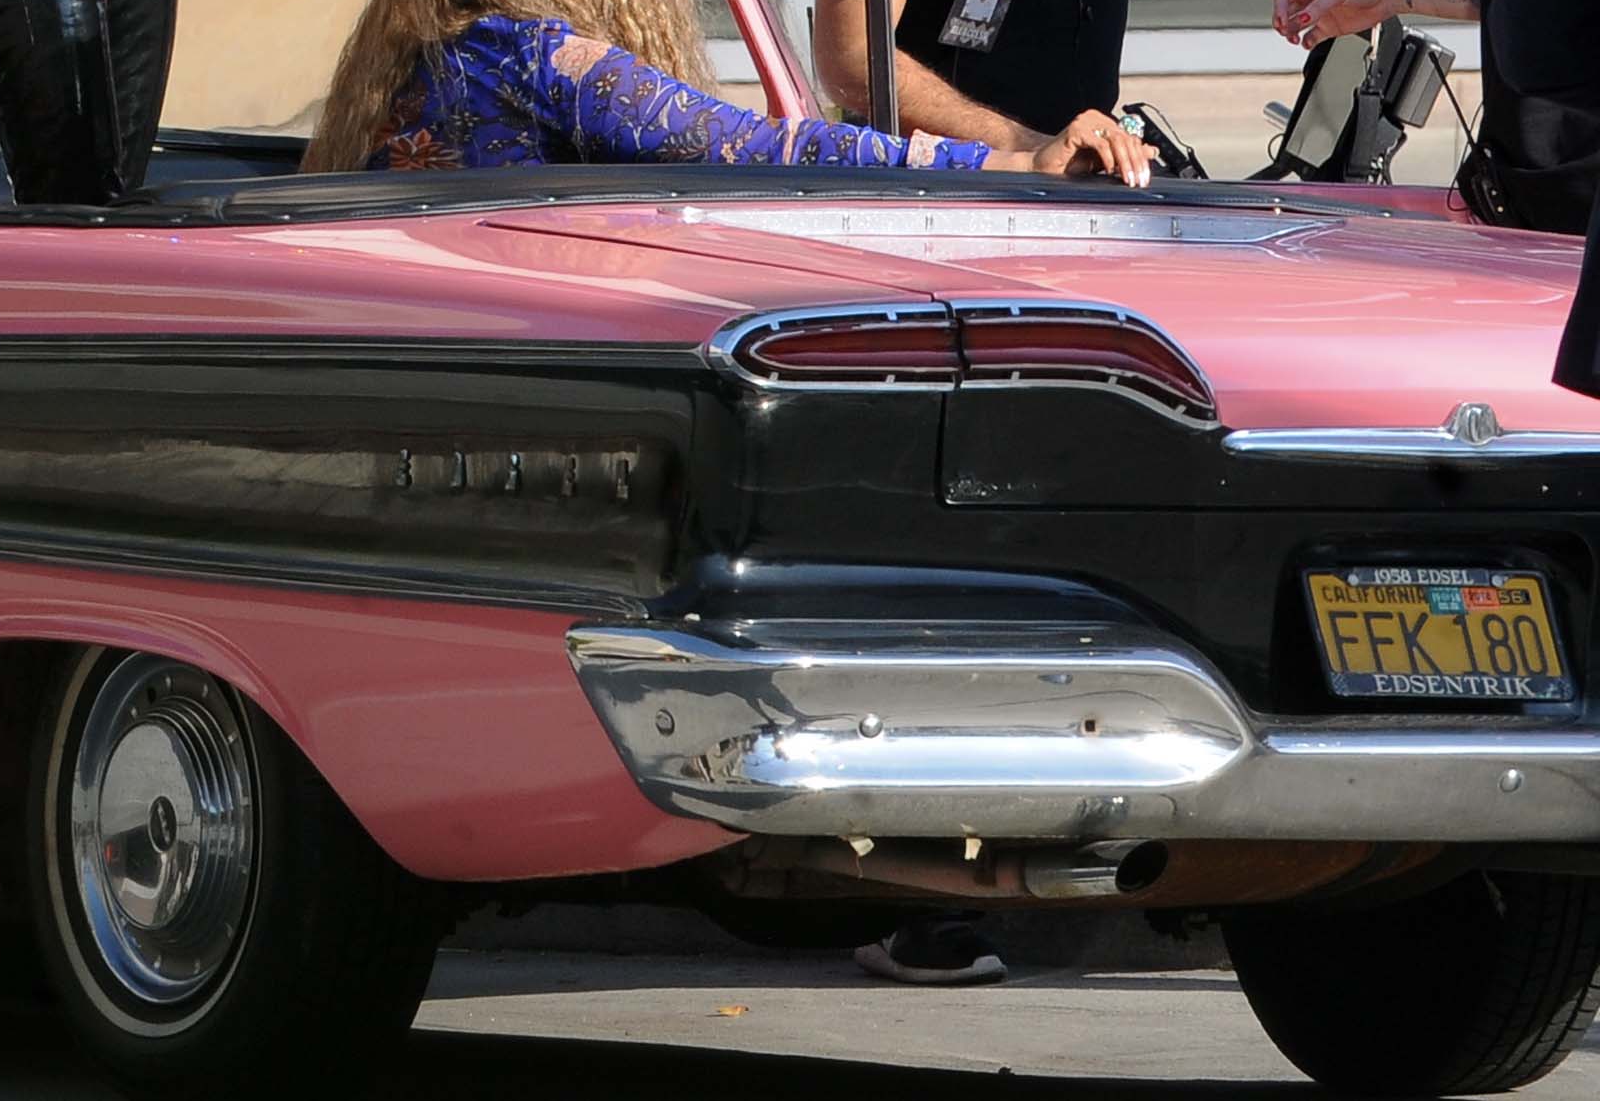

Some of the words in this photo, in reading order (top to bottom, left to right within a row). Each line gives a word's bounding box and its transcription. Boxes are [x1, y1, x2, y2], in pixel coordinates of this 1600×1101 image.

[1374, 567, 1412, 585] 1958
[1417, 568, 1475, 586] EDSEL
[1320, 585, 1429, 605] CALIFORNIA
[1328, 610, 1442, 675] FFK
[1453, 614, 1550, 676] 180
[1374, 673, 1536, 697] EDSENTRIK
